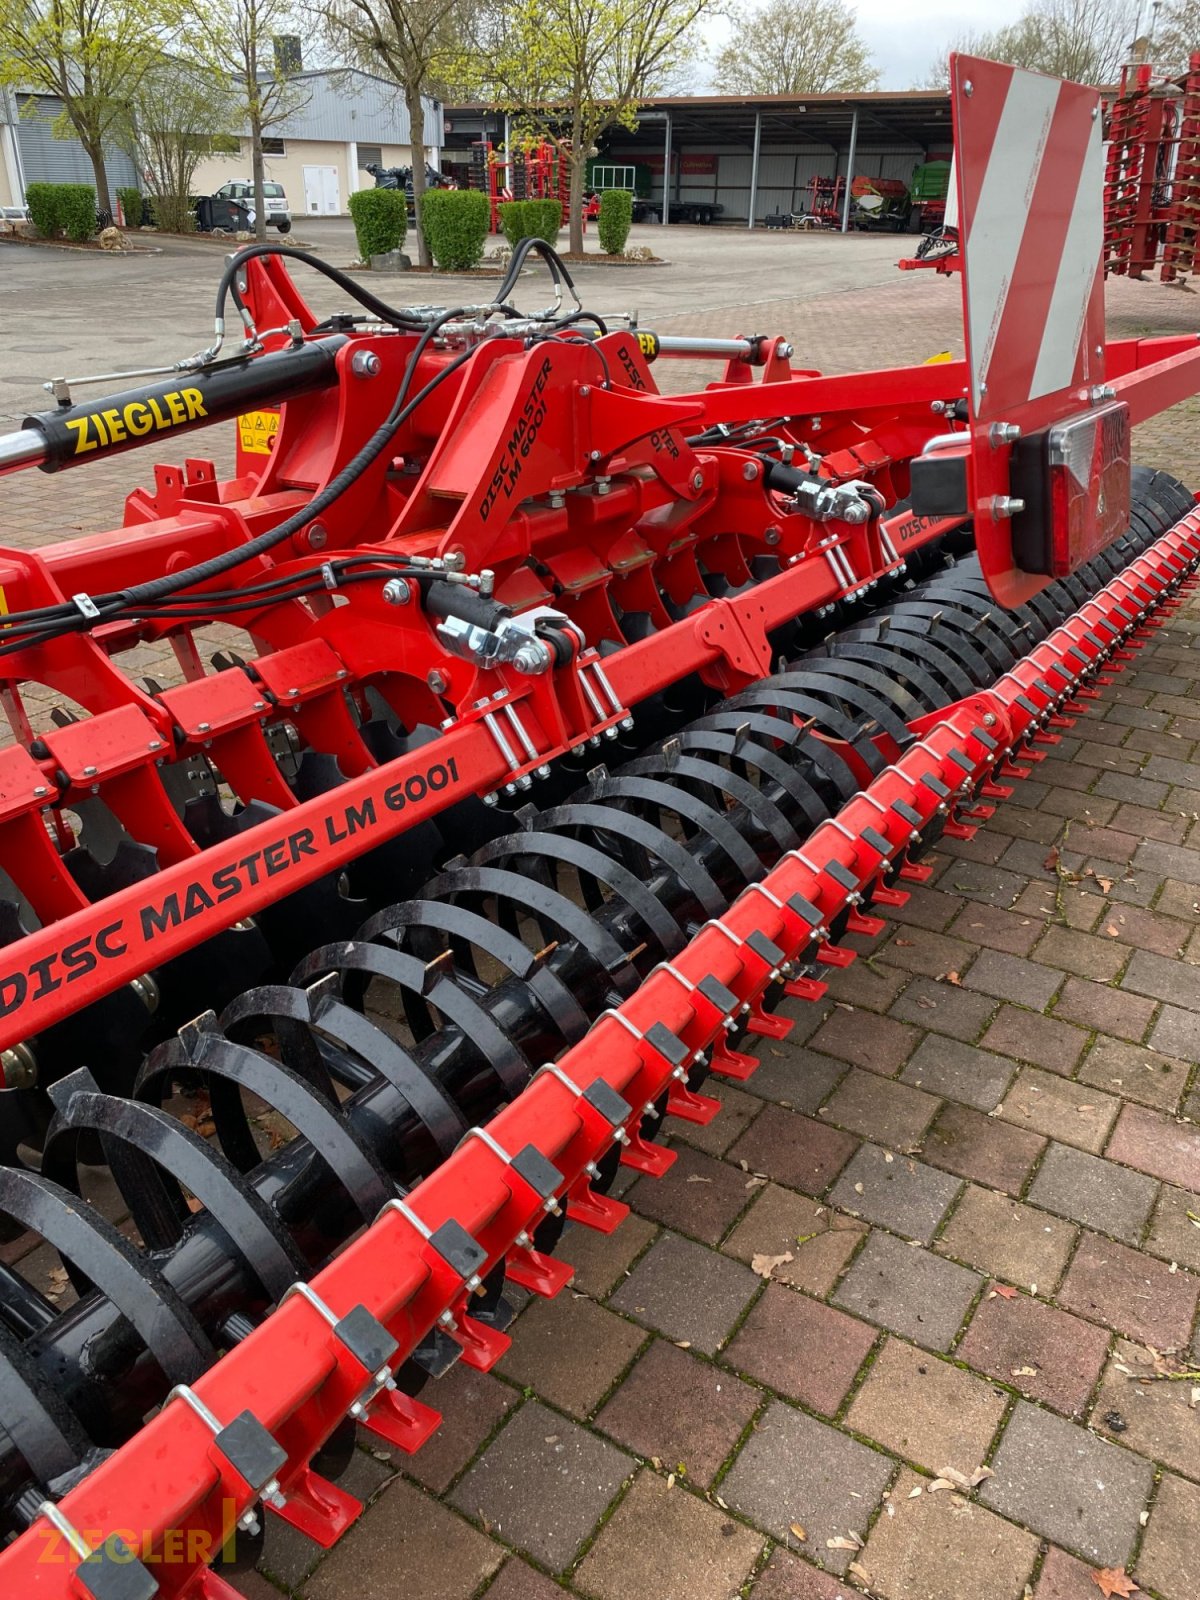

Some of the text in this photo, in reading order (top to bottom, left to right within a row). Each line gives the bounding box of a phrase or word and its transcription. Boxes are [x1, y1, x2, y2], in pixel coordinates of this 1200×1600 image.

[65, 388, 208, 454] ZIEGLER
[480, 356, 553, 522] DISC MASTER
[503, 398, 548, 499] LM 6001
[899, 517, 927, 541] DISC
[0, 757, 460, 1018] DISC MASTER LM 6001
